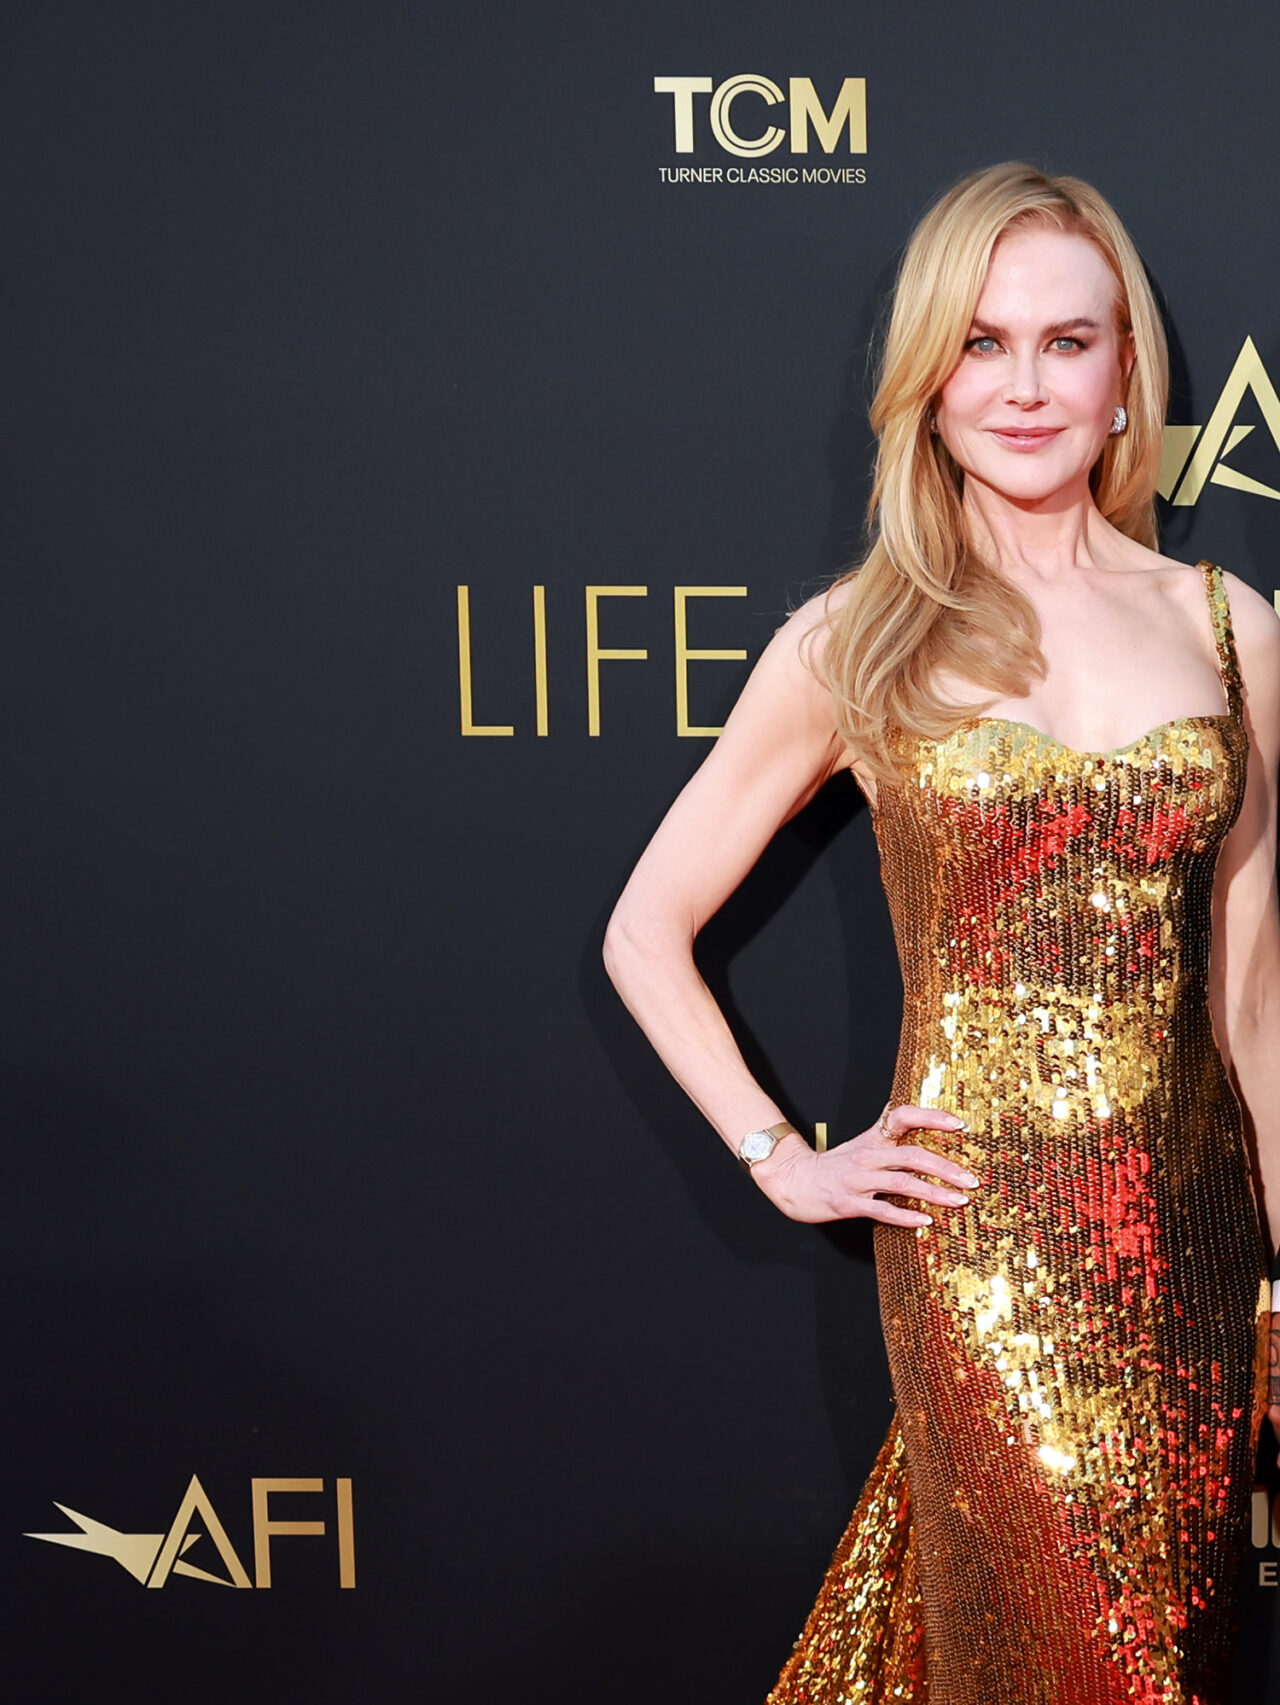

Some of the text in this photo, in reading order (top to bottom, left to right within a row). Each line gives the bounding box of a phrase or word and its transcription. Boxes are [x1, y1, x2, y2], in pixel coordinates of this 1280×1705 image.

[653, 73, 868, 158] TCM
[658, 167, 867, 183] TURNER CLASSIC MOVIES
[457, 585, 748, 737] LIFE
[146, 1473, 356, 1589] AFI
